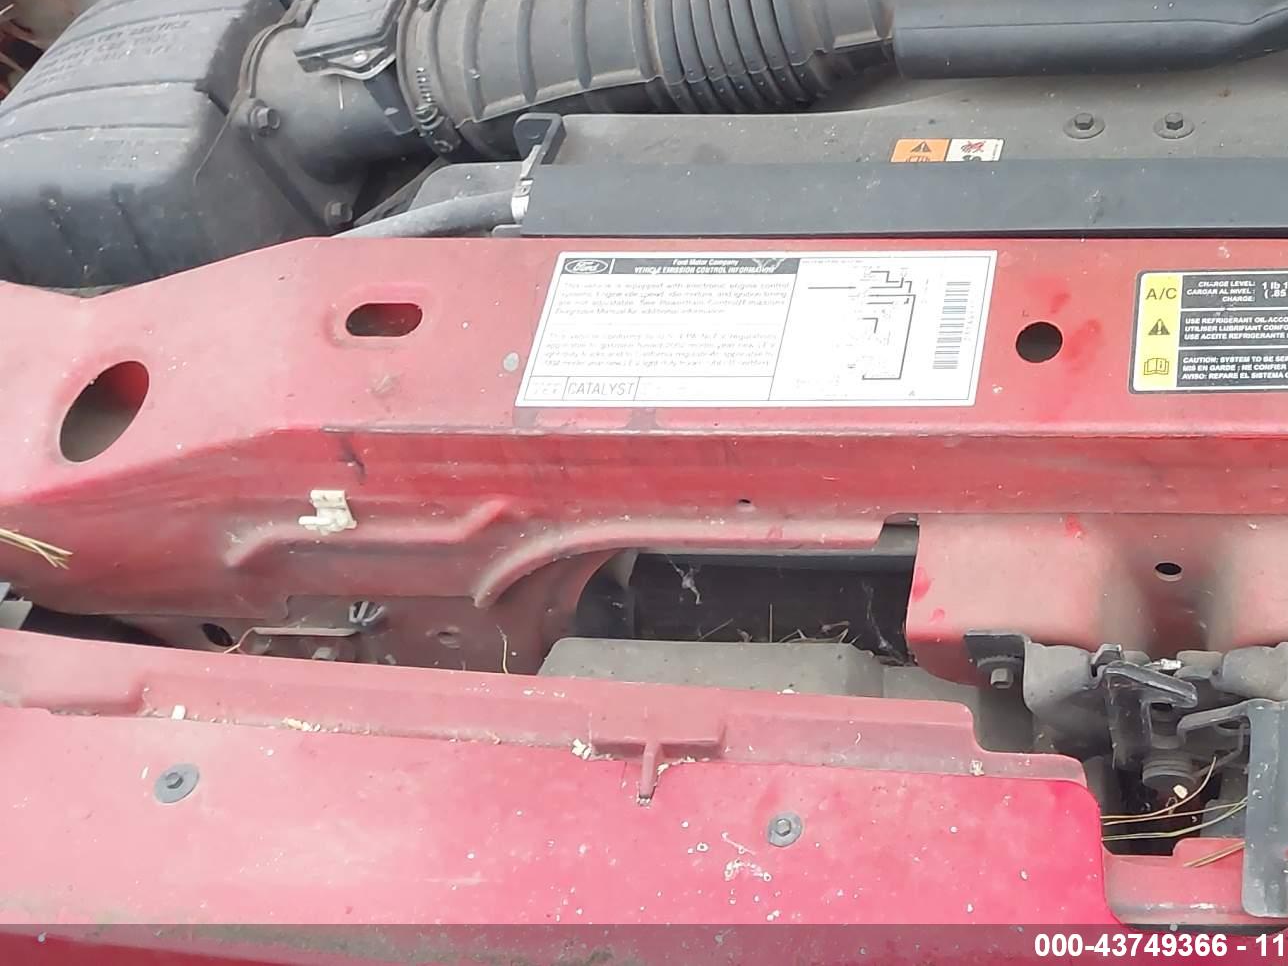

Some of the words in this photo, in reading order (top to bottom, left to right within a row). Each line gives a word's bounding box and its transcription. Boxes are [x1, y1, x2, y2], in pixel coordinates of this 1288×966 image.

[573, 261, 603, 272] Ford
[1146, 288, 1178, 300] A/C
[568, 382, 635, 396] CATALYST
